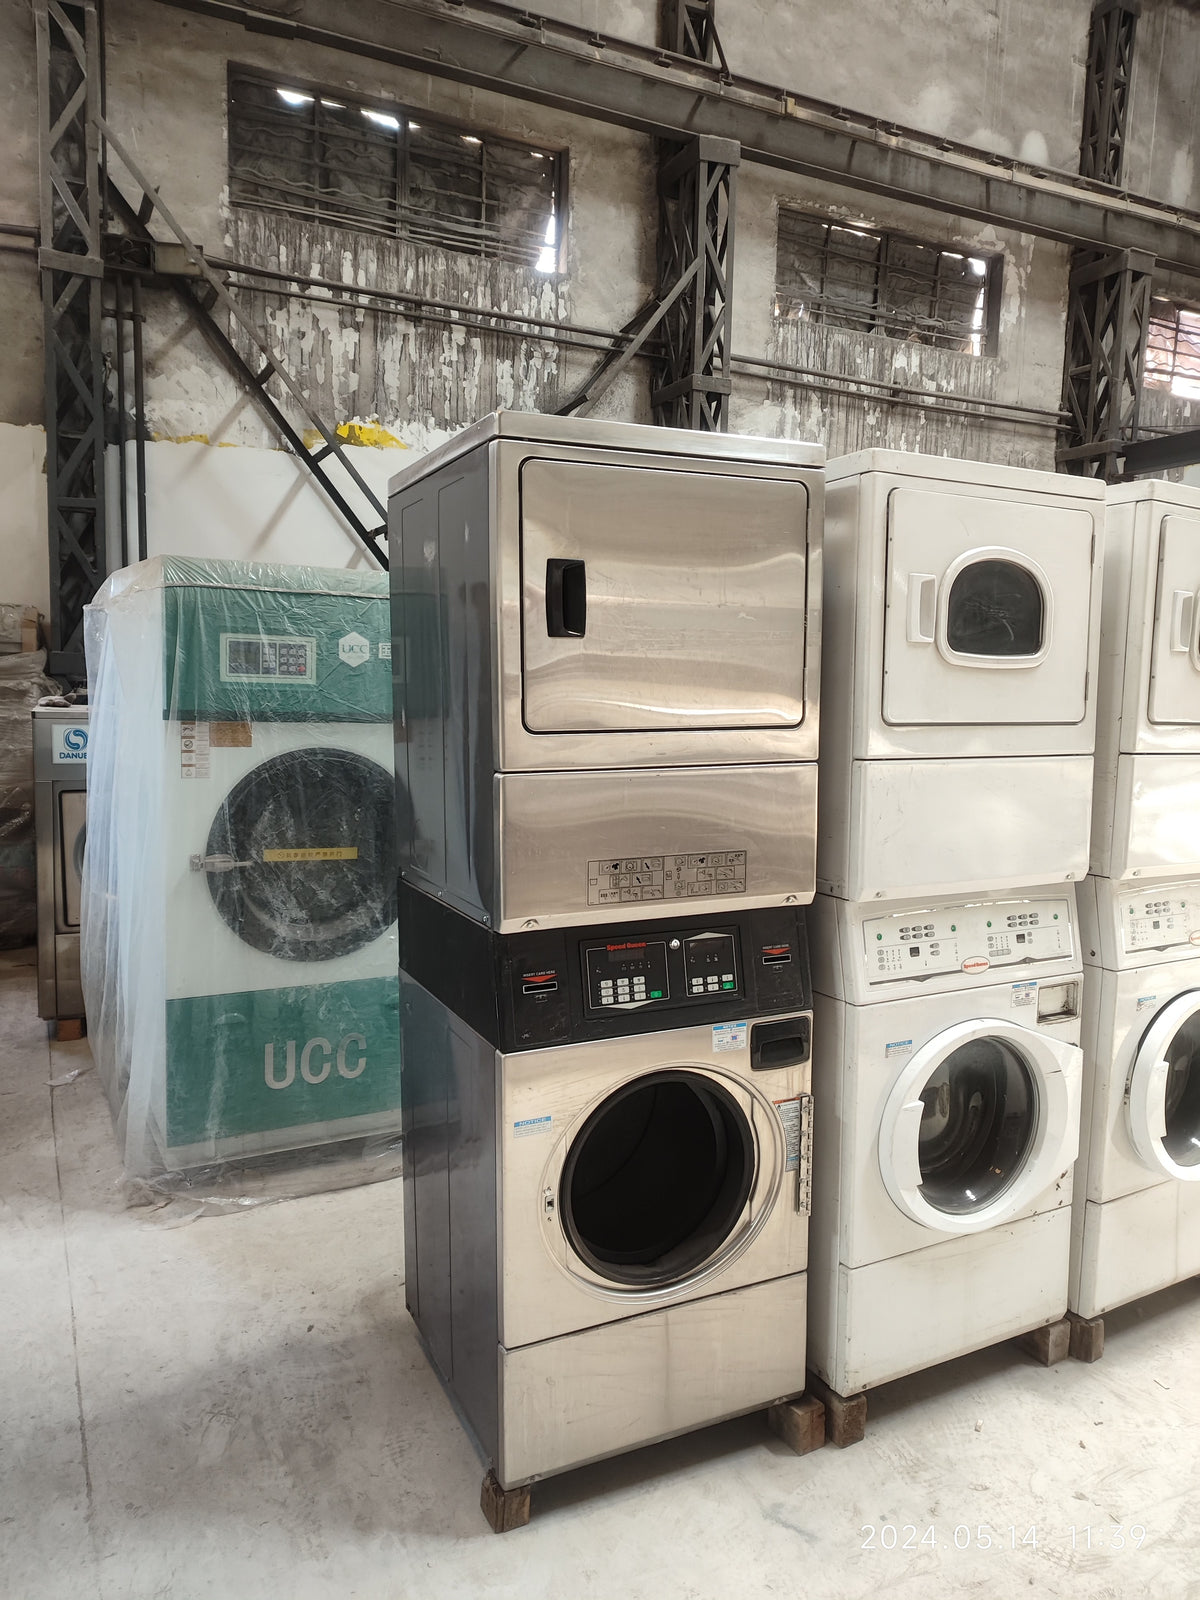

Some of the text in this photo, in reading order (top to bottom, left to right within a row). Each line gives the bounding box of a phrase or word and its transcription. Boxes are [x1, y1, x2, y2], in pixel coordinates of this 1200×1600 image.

[342, 644, 369, 654] UCC
[607, 943, 626, 951] Speed
[264, 1032, 367, 1090] UCC
[519, 1118, 546, 1126] NOTICE
